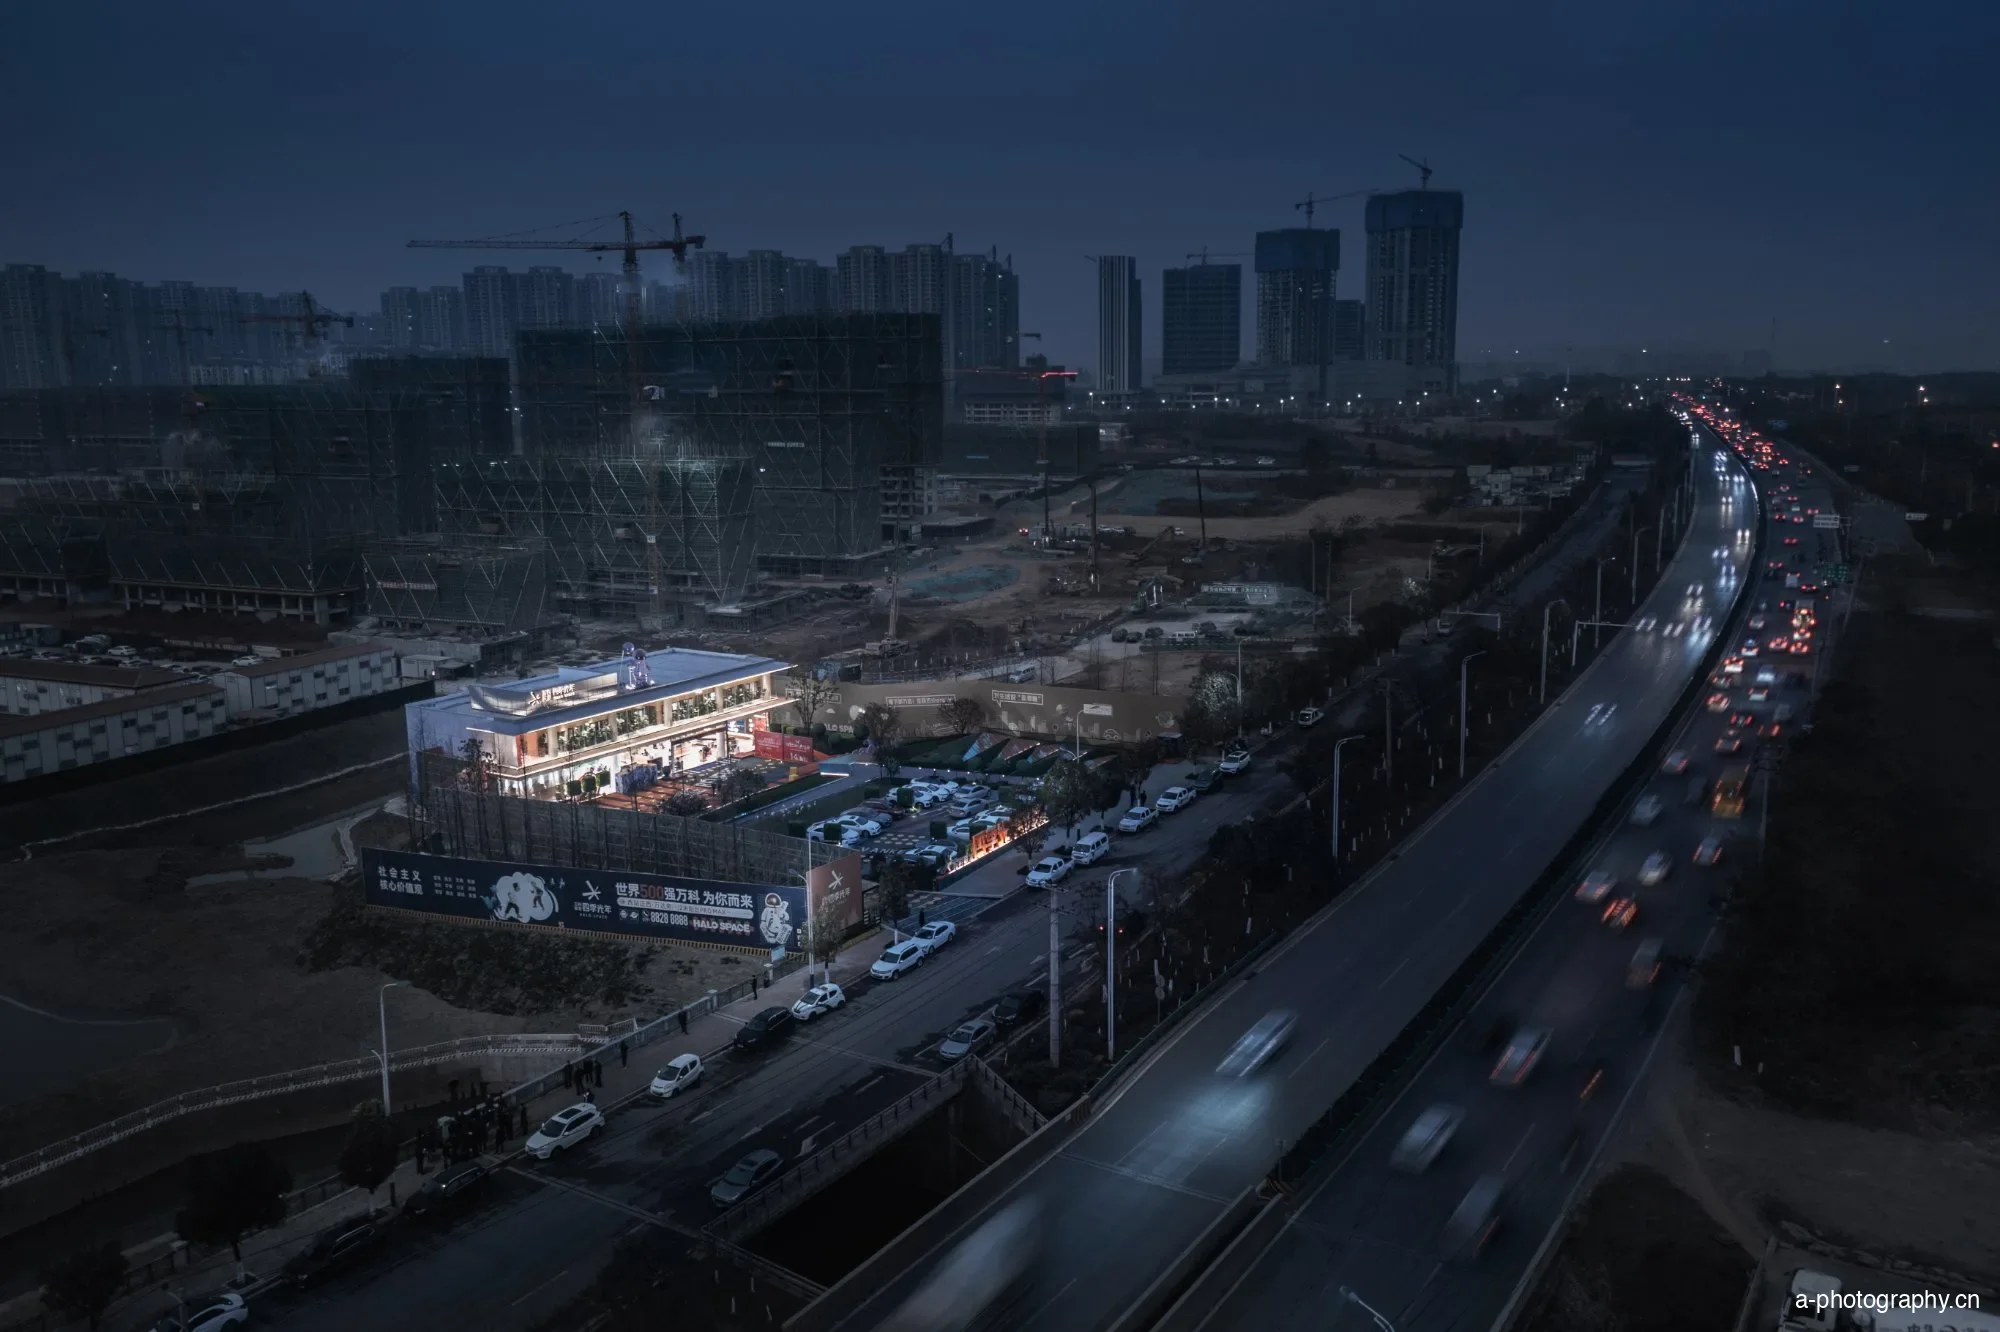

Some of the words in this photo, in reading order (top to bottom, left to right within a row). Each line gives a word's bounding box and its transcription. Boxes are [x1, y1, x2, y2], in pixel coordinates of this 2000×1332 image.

[377, 865, 422, 882] 社会主义
[615, 882, 700, 904] 世界500强万科
[703, 890, 754, 909] 为你而来
[693, 919, 719, 930] HALO
[720, 922, 751, 933] SPACE
